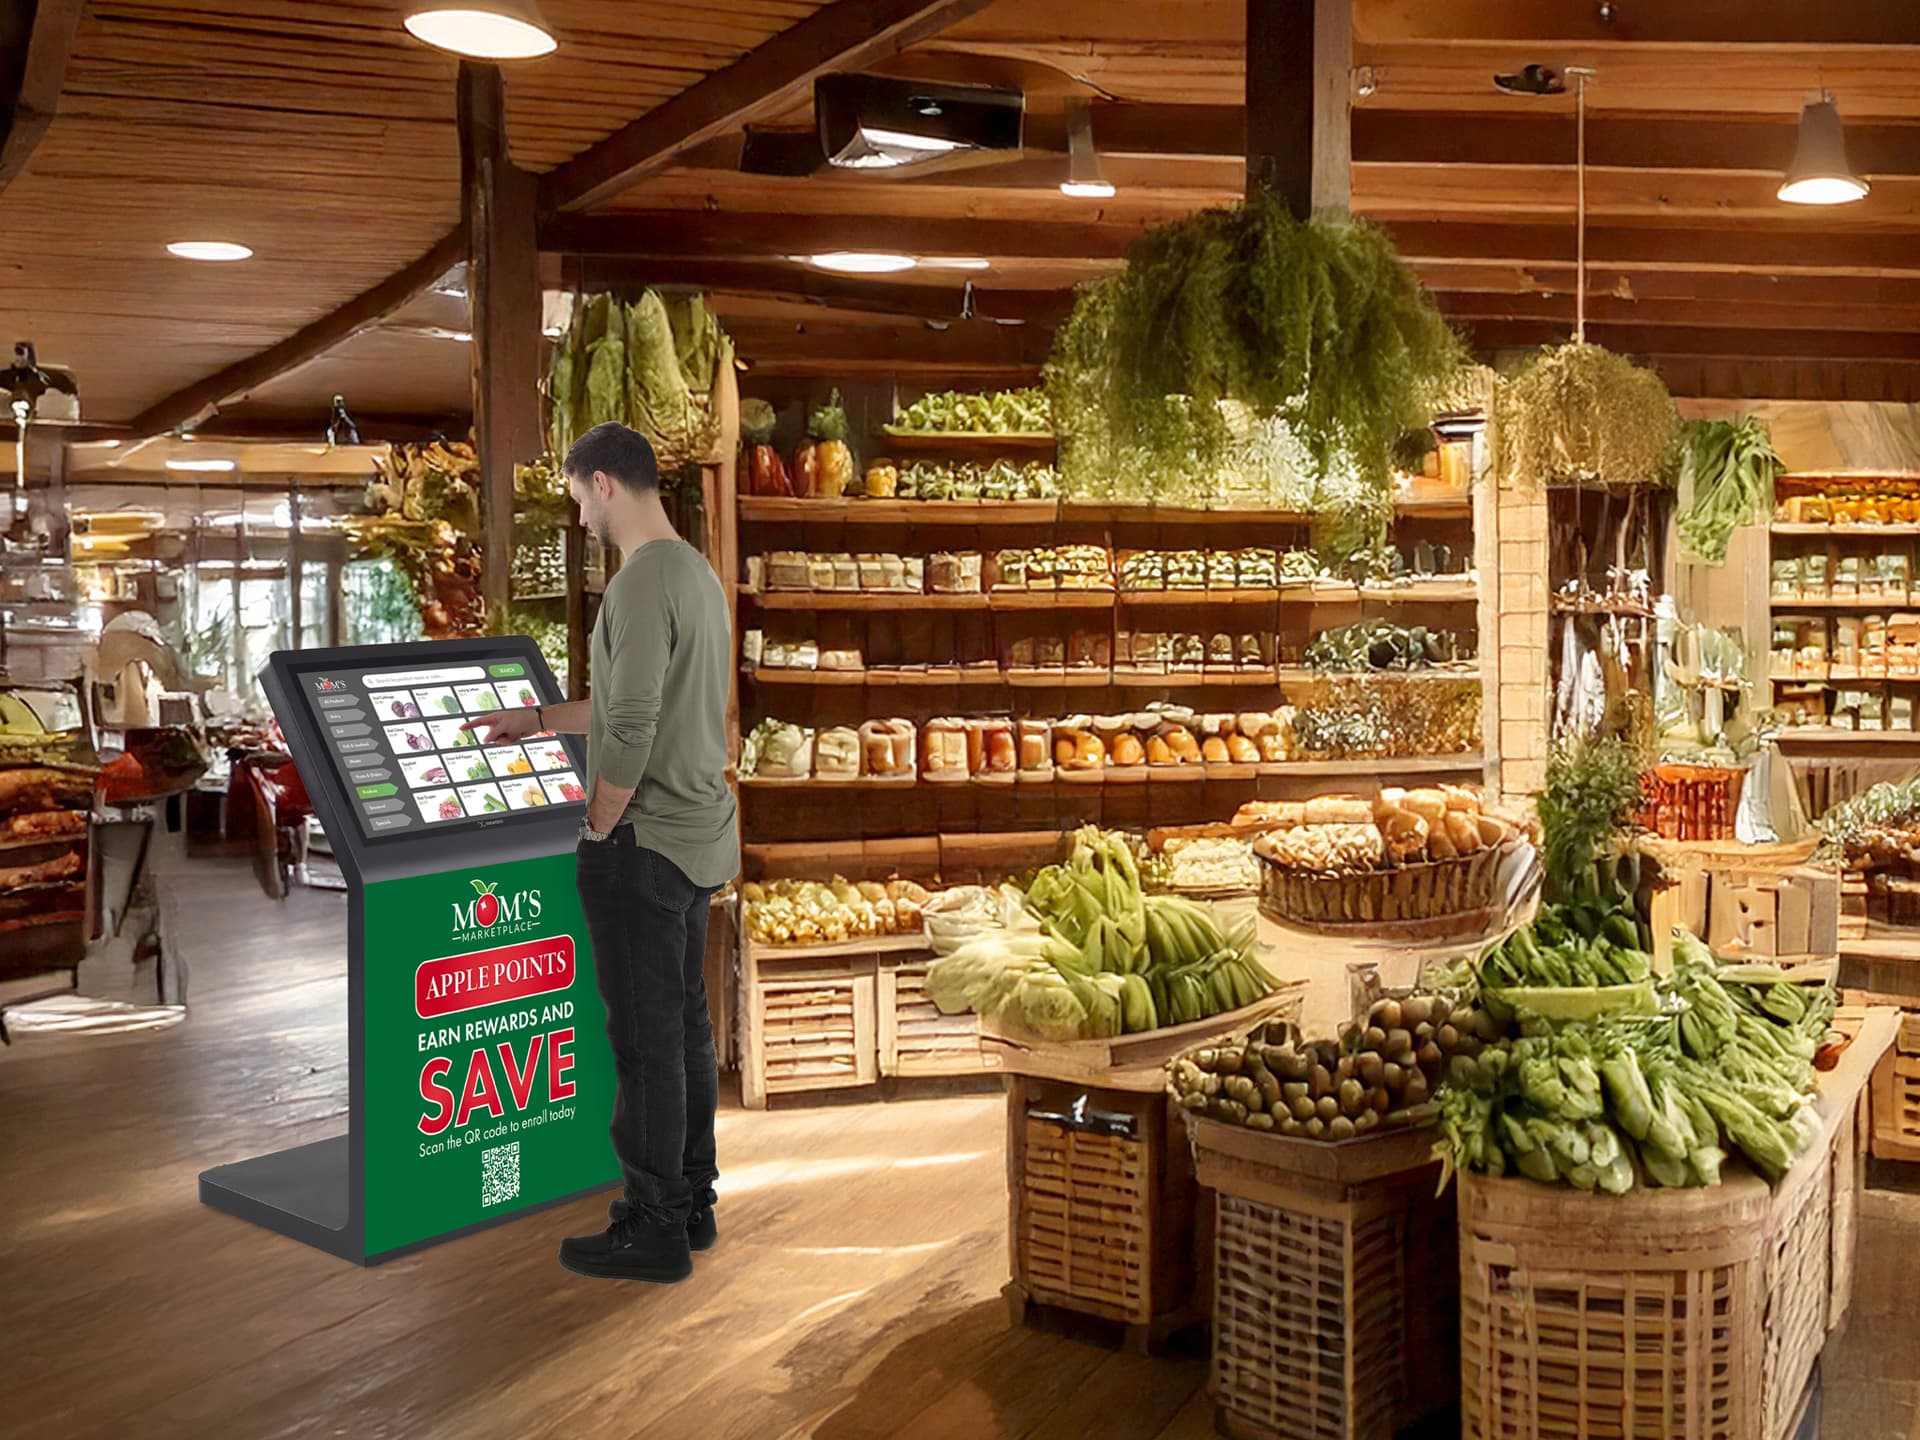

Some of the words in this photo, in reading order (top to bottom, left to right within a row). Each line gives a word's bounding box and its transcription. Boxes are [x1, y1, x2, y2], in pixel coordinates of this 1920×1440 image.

[462, 921, 532, 942] MARKETPLACE
[425, 965, 490, 1001] APPLE
[493, 950, 567, 986] POINTS
[418, 1025, 461, 1052] EARN
[465, 1008, 538, 1041] REWARDS
[541, 1001, 574, 1024] AND
[417, 1027, 576, 1136] SAVE
[419, 1142, 444, 1157] Scan
[447, 1135, 462, 1150] the
[464, 1129, 481, 1146] QR
[483, 1123, 508, 1140] code
[510, 1120, 519, 1131] to
[522, 1109, 547, 1129] enroll
[549, 1104, 576, 1121] today
